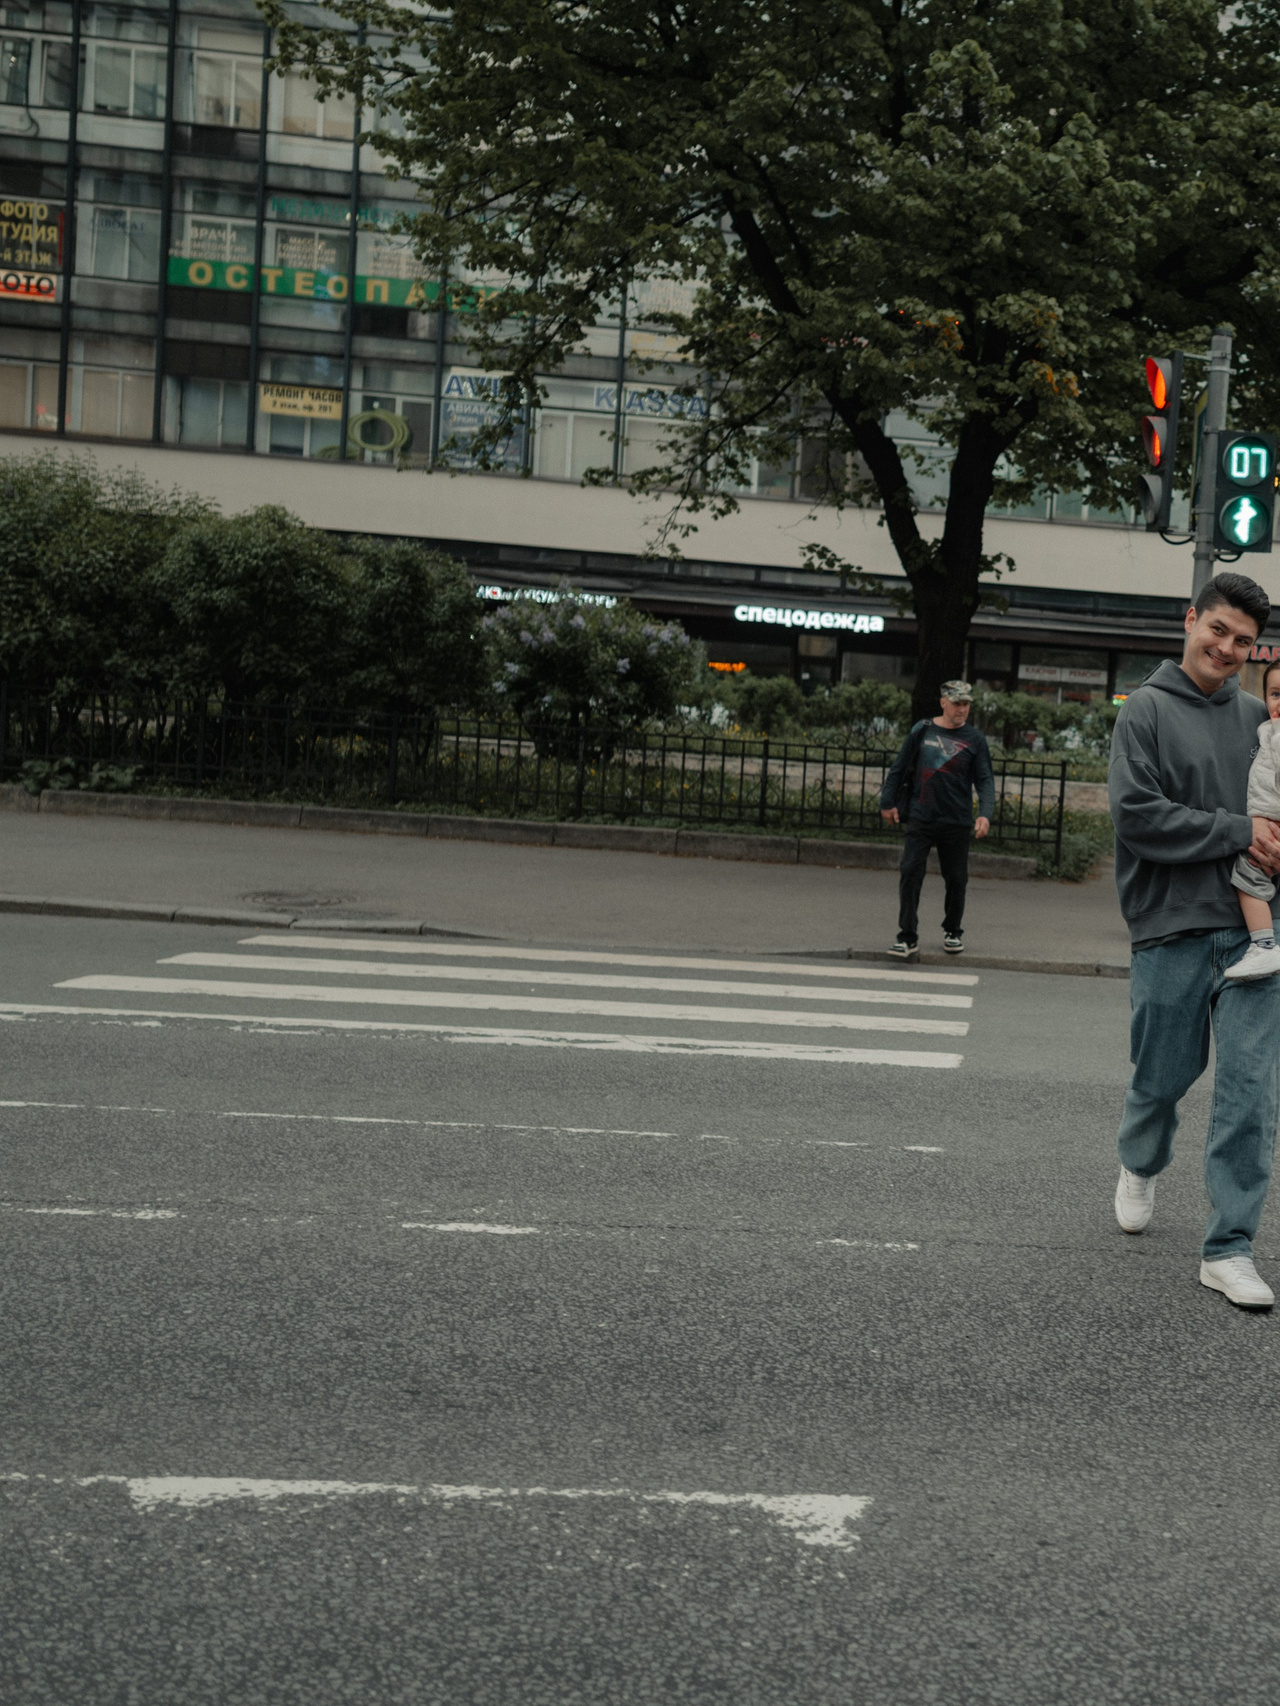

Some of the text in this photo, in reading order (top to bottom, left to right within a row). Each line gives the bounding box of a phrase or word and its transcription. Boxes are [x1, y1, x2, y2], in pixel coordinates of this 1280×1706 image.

[0, 201, 48, 221] ФОТО
[0, 273, 54, 295] ОТО
[308, 391, 342, 403] ЧАСОВ
[1231, 447, 1267, 478] 07
[734, 605, 884, 633] спецодежда
